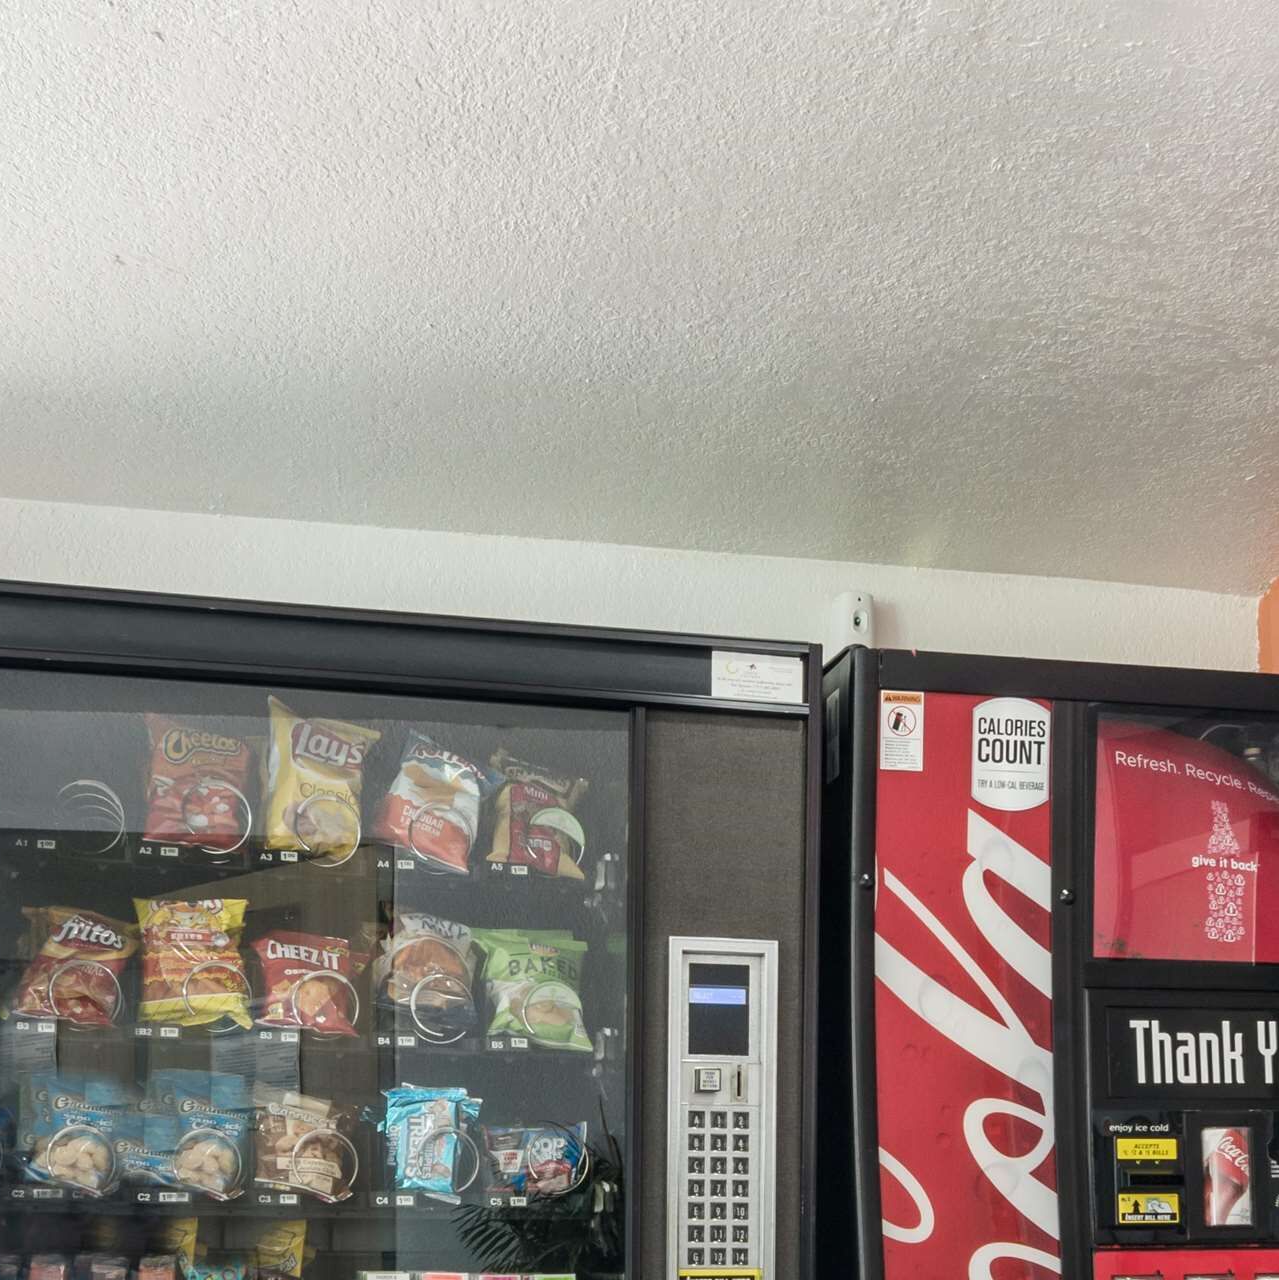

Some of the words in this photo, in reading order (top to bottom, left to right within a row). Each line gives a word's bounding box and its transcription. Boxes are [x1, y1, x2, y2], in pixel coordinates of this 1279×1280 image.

[978, 717, 1046, 738] CALORIES
[164, 730, 240, 762] Cheetos
[978, 738, 1045, 765] COUNT
[1115, 751, 1181, 774] Refresh.
[1186, 763, 1246, 791] Recycle.
[978, 779, 988, 790] TRY
[140, 847, 152, 855] A2
[377, 860, 389, 868] A4
[1191, 855, 1216, 868] give
[1219, 857, 1227, 867] it
[1230, 857, 1258, 872] back
[508, 955, 578, 978] BAKED
[378, 1037, 390, 1045] B4
[1129, 1020, 1245, 1084] Thank
[1109, 1124, 1132, 1133] enjoy
[1135, 1124, 1148, 1132] ice
[1150, 1123, 1169, 1132] cold
[138, 1193, 150, 1201] C2
[376, 1197, 388, 1205] C4
[490, 1198, 502, 1206] C5
[736, 1207, 744, 1216] 10
[714, 1230, 722, 1238] 11
[736, 1230, 744, 1239] 12
[736, 1253, 744, 1261] 14
